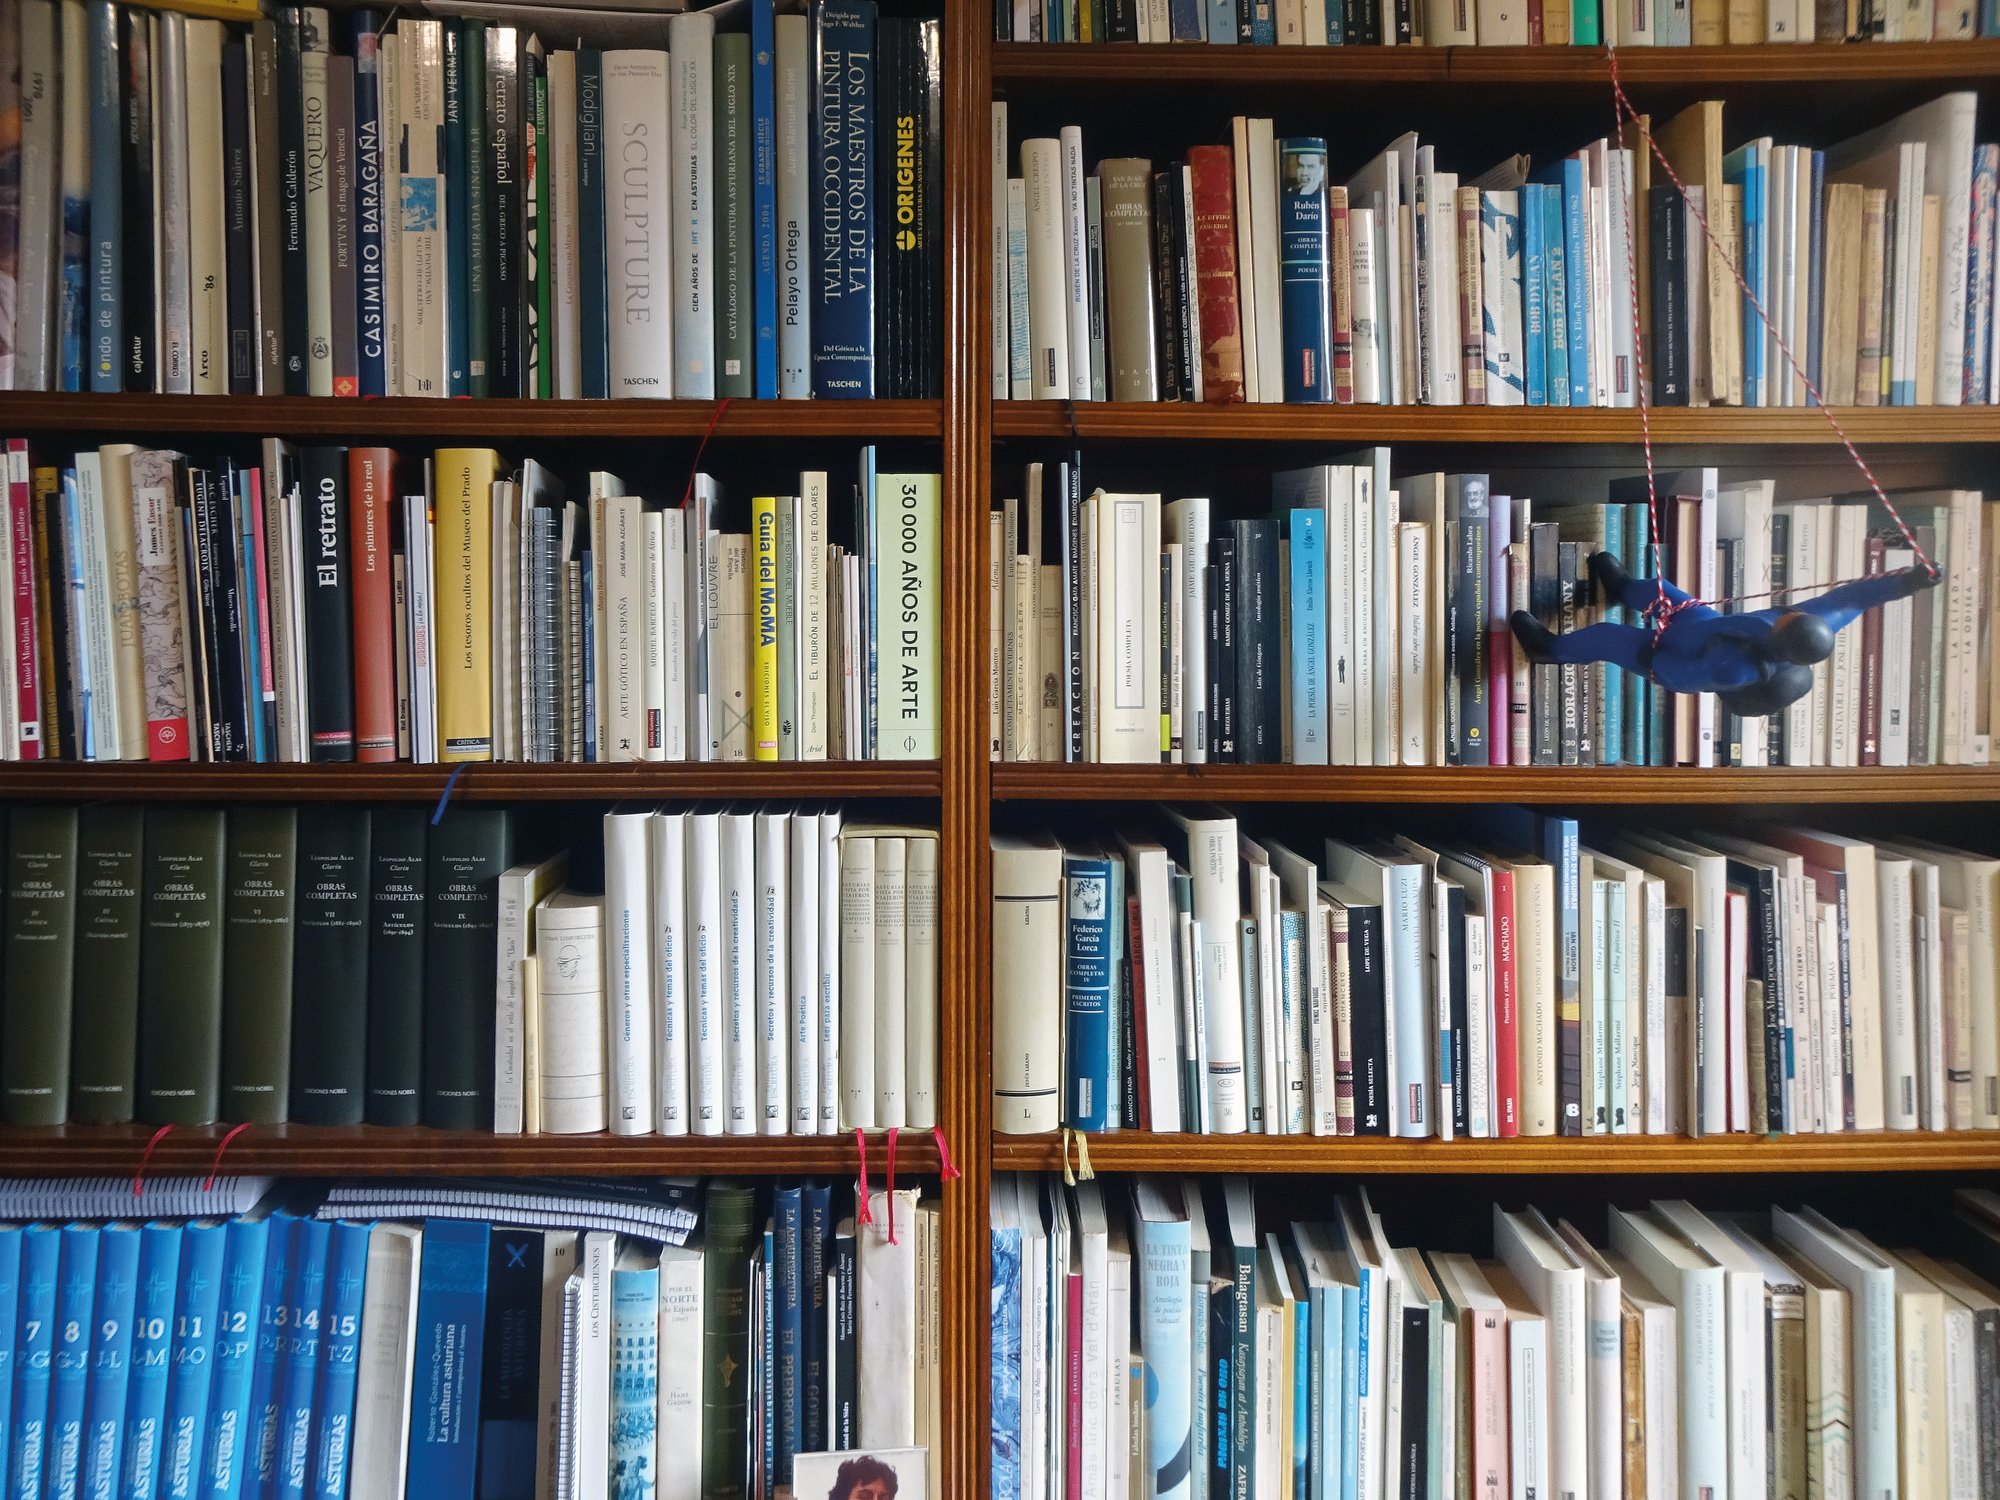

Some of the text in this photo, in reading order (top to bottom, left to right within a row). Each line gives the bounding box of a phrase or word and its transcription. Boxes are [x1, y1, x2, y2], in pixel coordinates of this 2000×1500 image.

[492, 74, 512, 184] retrato español
[578, 74, 598, 157] Modigliani
[306, 96, 327, 193] VAQUERO
[336, 128, 345, 162] Venecia
[337, 165, 346, 175] de
[823, 49, 841, 305] PINTURA OCCIDENTAL
[847, 103, 866, 221] MAESTROS
[896, 116, 914, 224] ORIGENES
[231, 148, 244, 233] Antonio Suárez
[338, 177, 349, 202] mago
[1070, 166, 1078, 190] TINTAS
[285, 150, 299, 251] Fernando Calderón
[337, 204, 346, 213] el
[470, 127, 481, 293] UNA MIRADA SINGULAR
[727, 64, 737, 340] CATÁLOGO DE LA PINTURA ASTURIANA DEL SIGLO XIX
[1071, 191, 1078, 201] NO
[1071, 202, 1078, 211] YA
[1294, 201, 1320, 210] Rubén
[621, 121, 651, 326] SCULPTURE
[1295, 211, 1319, 221] Darío
[358, 119, 381, 358] CASIMIRO BARAGAÑA
[848, 228, 866, 260] DE
[203, 275, 215, 292] '86
[785, 220, 800, 326] Pelayo Ortega
[849, 267, 866, 294] LA
[1529, 254, 1542, 334] BOB DYLAN
[98, 241, 115, 378] fondo de pintura
[133, 336, 144, 374] cajAstur
[199, 350, 209, 380] Arco
[623, 377, 659, 386] TASCHEN
[826, 380, 861, 388] TASCHEN
[363, 460, 378, 572] Los pintores de lo real
[808, 485, 819, 526] DÓLARES
[317, 477, 338, 587] El retrato
[810, 530, 819, 542] DE
[1466, 525, 1474, 574] Ricardo Labra
[1474, 525, 1482, 578] contemporánea
[461, 467, 473, 669] Los tesoros ocultos del Museo del Prado
[758, 512, 775, 647] Guía del MoMA
[810, 546, 819, 591] MILLONES
[708, 556, 719, 629] EL LOUVRE
[809, 595, 819, 606] 12
[902, 484, 922, 720] 30 000 AÑOS DE ARTE
[1474, 579, 1483, 610] española
[810, 611, 819, 623] DE
[1474, 610, 1483, 632] poesía
[617, 596, 629, 719] ARTE GÓTICO EN ESPAÑA
[808, 626, 819, 666] TIBURÓN
[1475, 641, 1482, 650] en
[1474, 651, 1482, 683] González
[1071, 650, 1081, 753] CREACIÓN
[1474, 684, 1483, 705] Ángel
[213, 722, 221, 752] TASCHEN
[225, 722, 233, 751] TASCHEN
[306, 891, 358, 900] COMPLETAS
[316, 883, 346, 891] OBRAS
[1533, 884, 1541, 918] SUEÑAN
[1072, 924, 1103, 933] Federico
[1401, 902, 1409, 932] MARIO
[623, 909, 631, 978] especializaciones
[665, 935, 673, 957] oficio
[1075, 934, 1100, 943] García
[1077, 943, 1098, 952] Lorca
[1501, 916, 1510, 962] MACHADO
[1534, 920, 1542, 946] ROCAS
[665, 960, 673, 973] del
[1364, 947, 1370, 956] DE
[823, 973, 831, 1003] escribir
[665, 1007, 673, 1041] Técnicas
[799, 995, 807, 1024] Poética
[824, 1005, 832, 1023] para
[1535, 1002, 1543, 1044] MACHADO
[623, 1010, 631, 1042] Géneros
[1535, 1046, 1544, 1086] ANTONIO
[1126, 1076, 1135, 1122] AMANCIO PRADA
[1145, 1243, 1189, 1256] LA TINTA
[1148, 1259, 1179, 1272] NEGRA
[590, 1247, 601, 1339] LOS CISTERCIENSES
[1155, 1275, 1180, 1288] ROJA
[1235, 1264, 1250, 1333] Balagtasan
[137, 1318, 165, 1340] 10
[178, 1316, 203, 1338] 11
[221, 1310, 247, 1333] 12
[262, 1306, 287, 1325] 13
[294, 1307, 319, 1330] 14
[329, 1315, 356, 1336] 15
[1197, 1291, 1207, 1354] Horacio Salas
[26, 1320, 41, 1343] 7
[63, 1320, 81, 1343] 8
[102, 1320, 119, 1342] 9
[437, 1323, 457, 1443] La cultura asturiana
